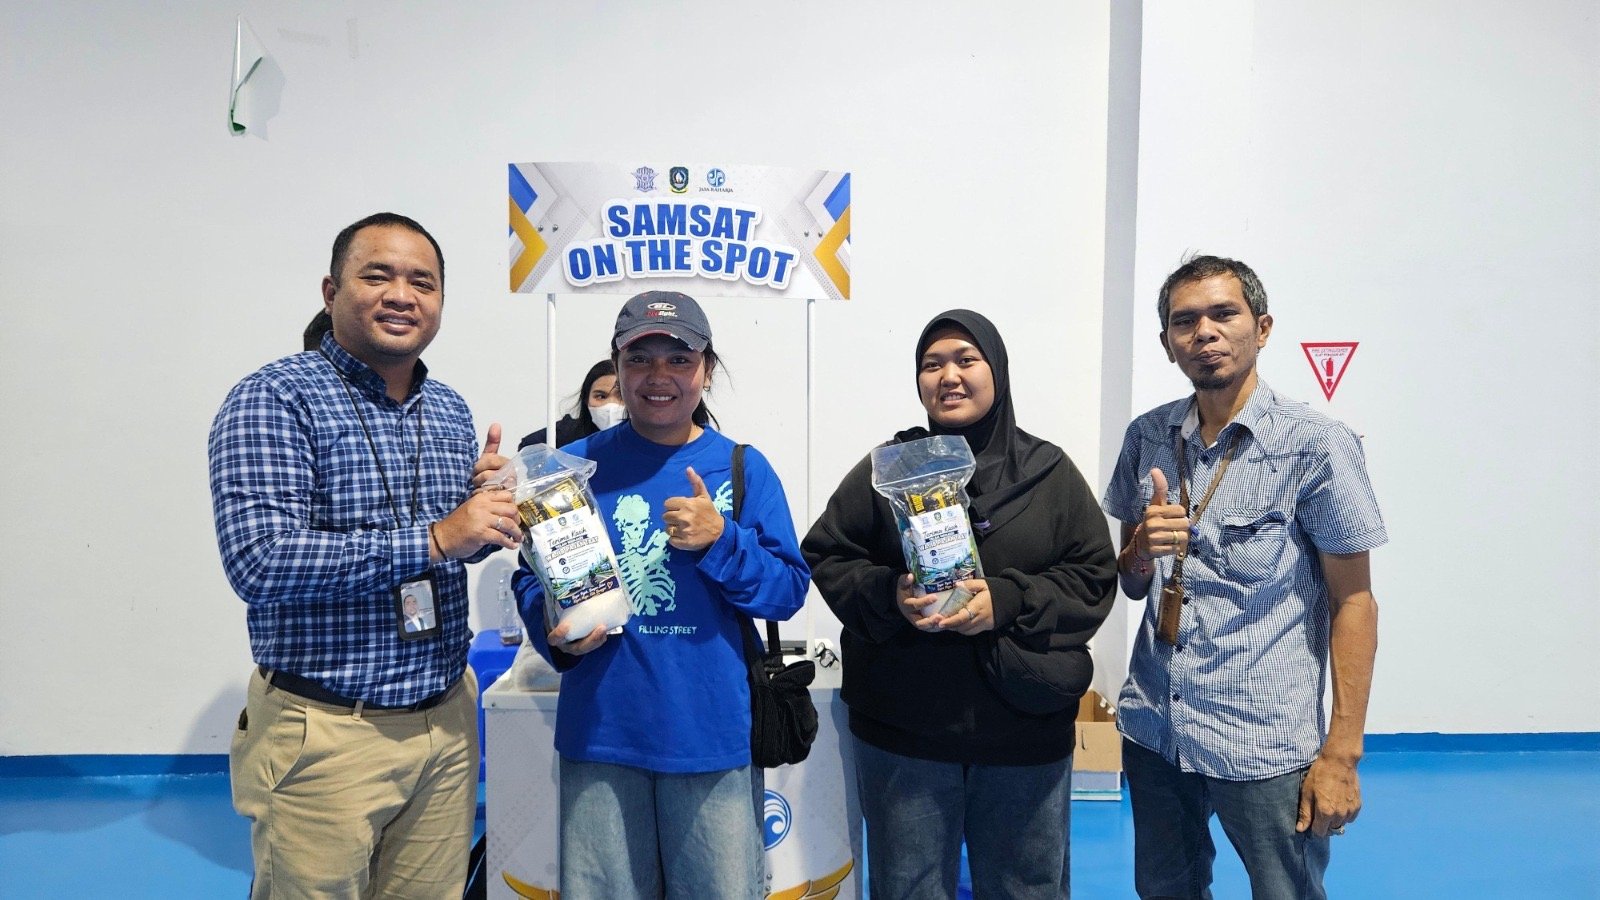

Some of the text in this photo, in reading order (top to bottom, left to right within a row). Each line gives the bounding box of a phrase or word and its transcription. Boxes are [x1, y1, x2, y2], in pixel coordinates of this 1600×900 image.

[607, 203, 757, 242] SAMSAT
[568, 239, 795, 283] ON THE SPOT
[638, 625, 698, 635] FILLING STREET
